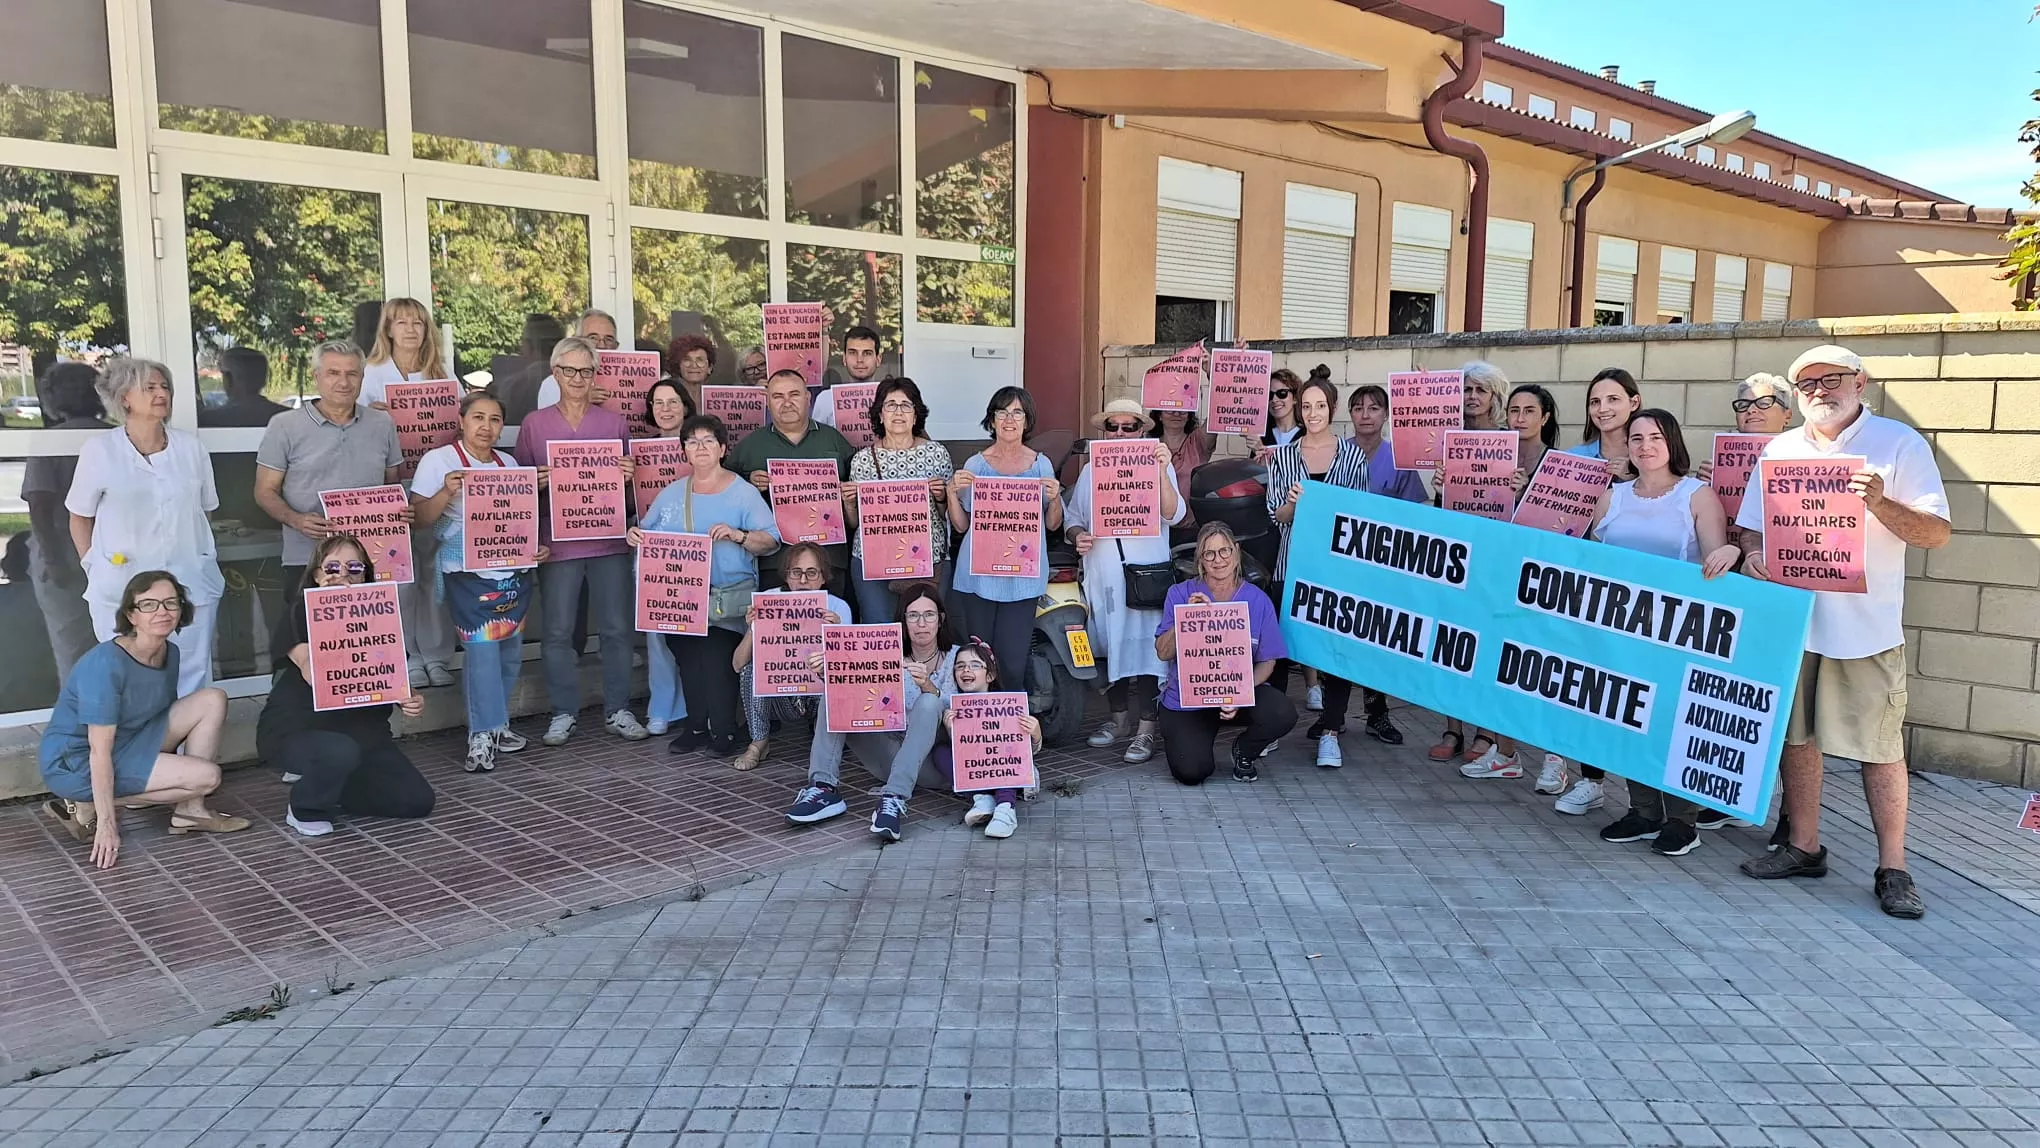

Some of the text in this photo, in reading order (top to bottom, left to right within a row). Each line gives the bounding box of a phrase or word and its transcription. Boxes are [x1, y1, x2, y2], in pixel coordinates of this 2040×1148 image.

[768, 332, 805, 340] ESTAMOS
[769, 342, 819, 350] ENFERMERAS
[1215, 363, 1267, 374] ESTAMOS
[1215, 386, 1264, 395] AUXILIARES
[1392, 386, 1460, 397] NO SE JUEGA
[390, 395, 456, 409] ESTAMOS
[707, 400, 761, 410] ESTAMOS
[417, 411, 434, 420] SIN
[1217, 406, 1259, 415] EDUCACIÓN
[1393, 405, 1460, 416] ESTAMOS SIN
[1218, 417, 1256, 425] ESPECIAL
[1394, 418, 1459, 428] ENFERMERAS
[396, 422, 456, 433] AUXILIARES
[422, 435, 434, 444] DE
[1100, 446, 1124, 454] CURSO
[1448, 448, 1512, 460] ESTAMOS
[554, 455, 619, 468] ESTAMOS
[1095, 454, 1155, 467] ESTAMOS
[1547, 456, 1572, 467] CON LA
[659, 467, 675, 476] SIN
[1471, 464, 1487, 472] SIN
[1774, 465, 1850, 476] CURSO 23/24
[474, 474, 500, 482] CURSO
[578, 470, 595, 479] SIN
[1117, 470, 1133, 478] SIN
[1540, 465, 1608, 485] NO SE JUEGA
[1098, 481, 1153, 491] AUXILIARES
[1451, 476, 1509, 486] AUXILIARES
[468, 483, 533, 496] ESTAMOS
[558, 482, 618, 492] AUXILIARES
[773, 483, 818, 493] ESTAMOS
[366, 495, 404, 504] JUEGA
[776, 493, 837, 505] ENFERMERAS
[861, 493, 927, 505] NO SE JUEGA
[975, 492, 1039, 502] NO SE JUEGA
[1120, 494, 1131, 502] DE
[1473, 490, 1485, 498] DE
[1532, 483, 1599, 505] ESTAMOS SIN
[493, 499, 510, 508] SIN
[582, 496, 594, 504] DE
[1801, 499, 1825, 510] SIN
[562, 505, 615, 517] EDUCACIÓN
[1101, 504, 1150, 515] EDUCACIÓN
[1453, 500, 1504, 512] EDUCACIÓN
[1526, 495, 1593, 517] ENFERMERAS
[471, 510, 532, 521] AUXILIARES
[863, 512, 927, 523] ESTAMOS SIN
[975, 510, 1039, 520] ESTAMOS SIN
[566, 520, 612, 529] ESPECIAL
[975, 522, 1038, 532] ENFERMERAS
[1104, 518, 1147, 527] ESPECIAL
[1772, 515, 1856, 528] AUXILIARES
[495, 524, 507, 533] DE
[864, 524, 928, 535] ENFERMERAS
[474, 535, 528, 546] EDUCACIÓN
[649, 538, 702, 548] CURSO 23/24
[1806, 533, 1822, 544] DE
[478, 550, 523, 559] ESPECIAL
[643, 547, 707, 562] ESTAMOS
[1778, 548, 1851, 562] EDUCACIÓN
[665, 563, 682, 572] SIN
[1782, 565, 1847, 579] ESPECIAL
[644, 574, 703, 586] AUXILIARES
[1331, 514, 1736, 659] EXIGIMOS CONTRATAR
[319, 591, 386, 604] CURSO 23/24
[667, 589, 678, 597] DE
[647, 599, 698, 611] EDUCACIÓN
[793, 598, 818, 606] 23/24
[313, 601, 394, 622] ESTAMOS
[757, 608, 823, 619] ESTAMOS
[1185, 609, 1239, 618] CURSO 23/24
[649, 612, 694, 623] ESPECIAL
[346, 621, 368, 633] SIN
[782, 622, 800, 631] SIN
[1180, 618, 1245, 632] ESTAMOS
[857, 629, 898, 638] EDUCACIÓN
[319, 634, 396, 651] AUXILIARES
[760, 635, 822, 645] AUXILIARES
[1205, 635, 1222, 644] SIN
[826, 640, 899, 651] NO SE JUEGA
[352, 652, 368, 663] DE
[785, 649, 797, 657] DE
[1184, 647, 1245, 657] AUXILIARES
[1290, 581, 1651, 729] PERSONAL NO DOCENTE
[828, 660, 900, 671] ESTAMOS SIN
[1209, 661, 1221, 669] DE
[326, 662, 395, 681] EDUCACIÓN
[1190, 671, 1243, 683] EDUCACIÓN
[768, 674, 815, 684] ESPECIAL
[829, 674, 900, 684] ENFERMERAS
[332, 680, 392, 695] ESPECIAL
[1194, 686, 1240, 695] ESPECIAL
[1688, 669, 1773, 714] ENFERMERAS
[955, 706, 1024, 719] ESTAMOS
[982, 721, 1000, 730] SIN
[1685, 703, 1762, 745] AUXILIARES
[960, 734, 1023, 744] AUXILIARES
[986, 746, 999, 755] DE
[1687, 736, 1746, 776] LIMPIEZA
[965, 755, 1022, 768] EDUCACIÓN
[969, 769, 1019, 780] ESPECIAL
[1681, 766, 1743, 806] CONSERJE
